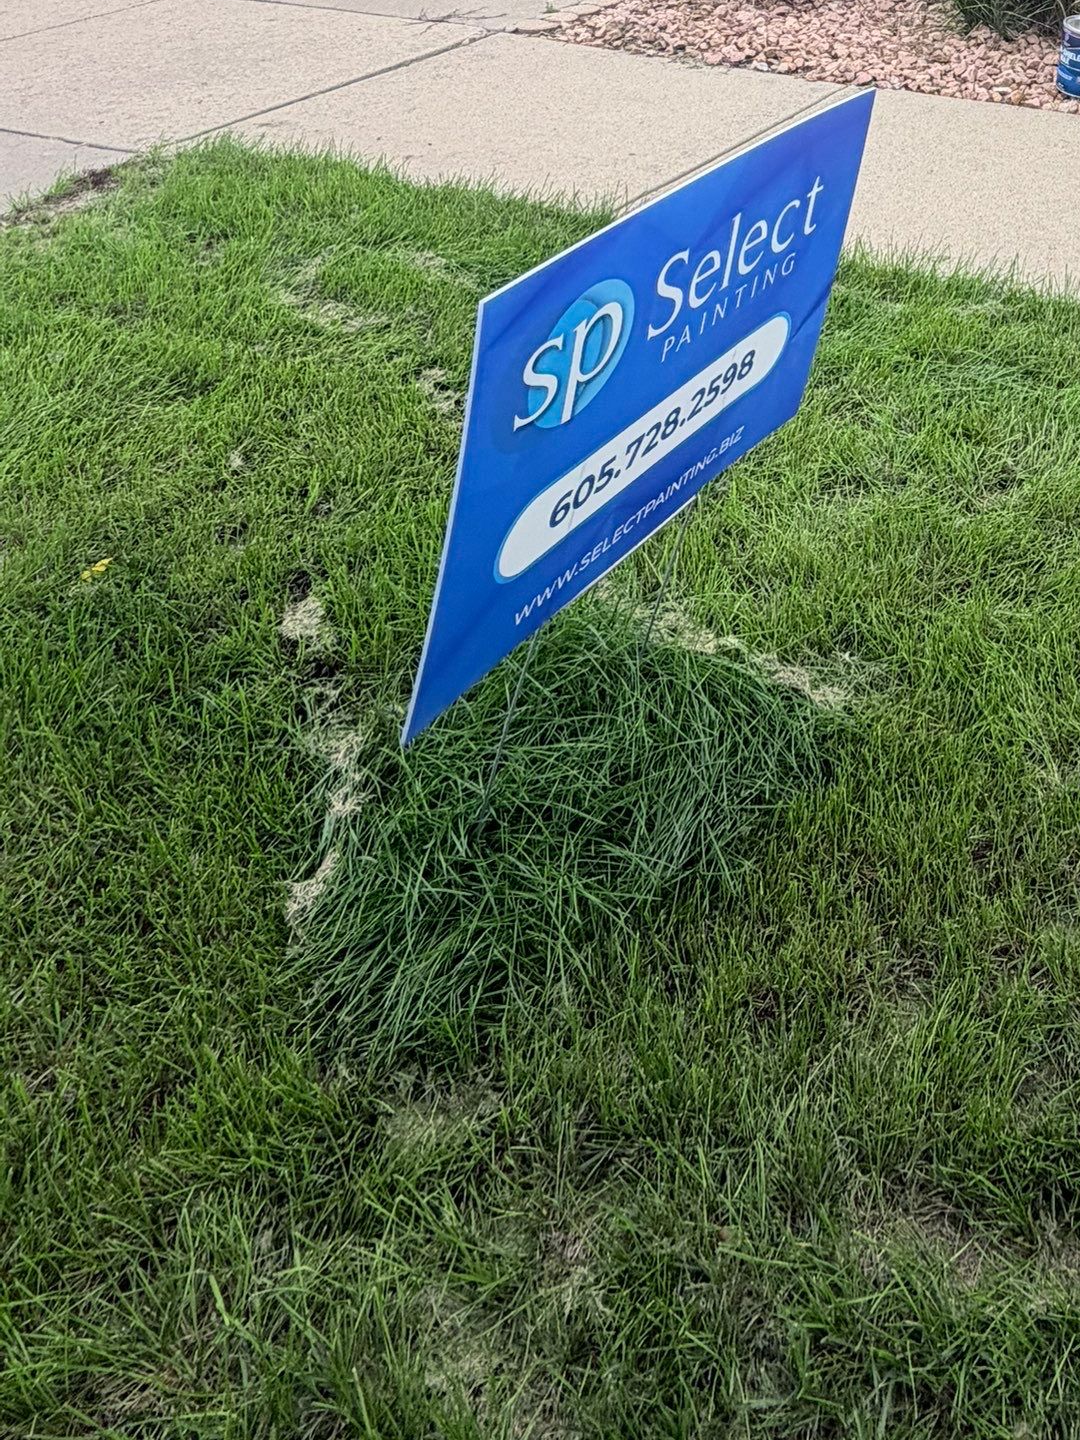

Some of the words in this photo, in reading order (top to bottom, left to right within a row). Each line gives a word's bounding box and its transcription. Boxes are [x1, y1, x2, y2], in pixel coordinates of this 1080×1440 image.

[647, 175, 824, 342] Select
[661, 252, 797, 363] PAINTING
[549, 349, 756, 528] 605.728.2598
[514, 425, 745, 627] WWW.SELECTPAINTING.BIZ
